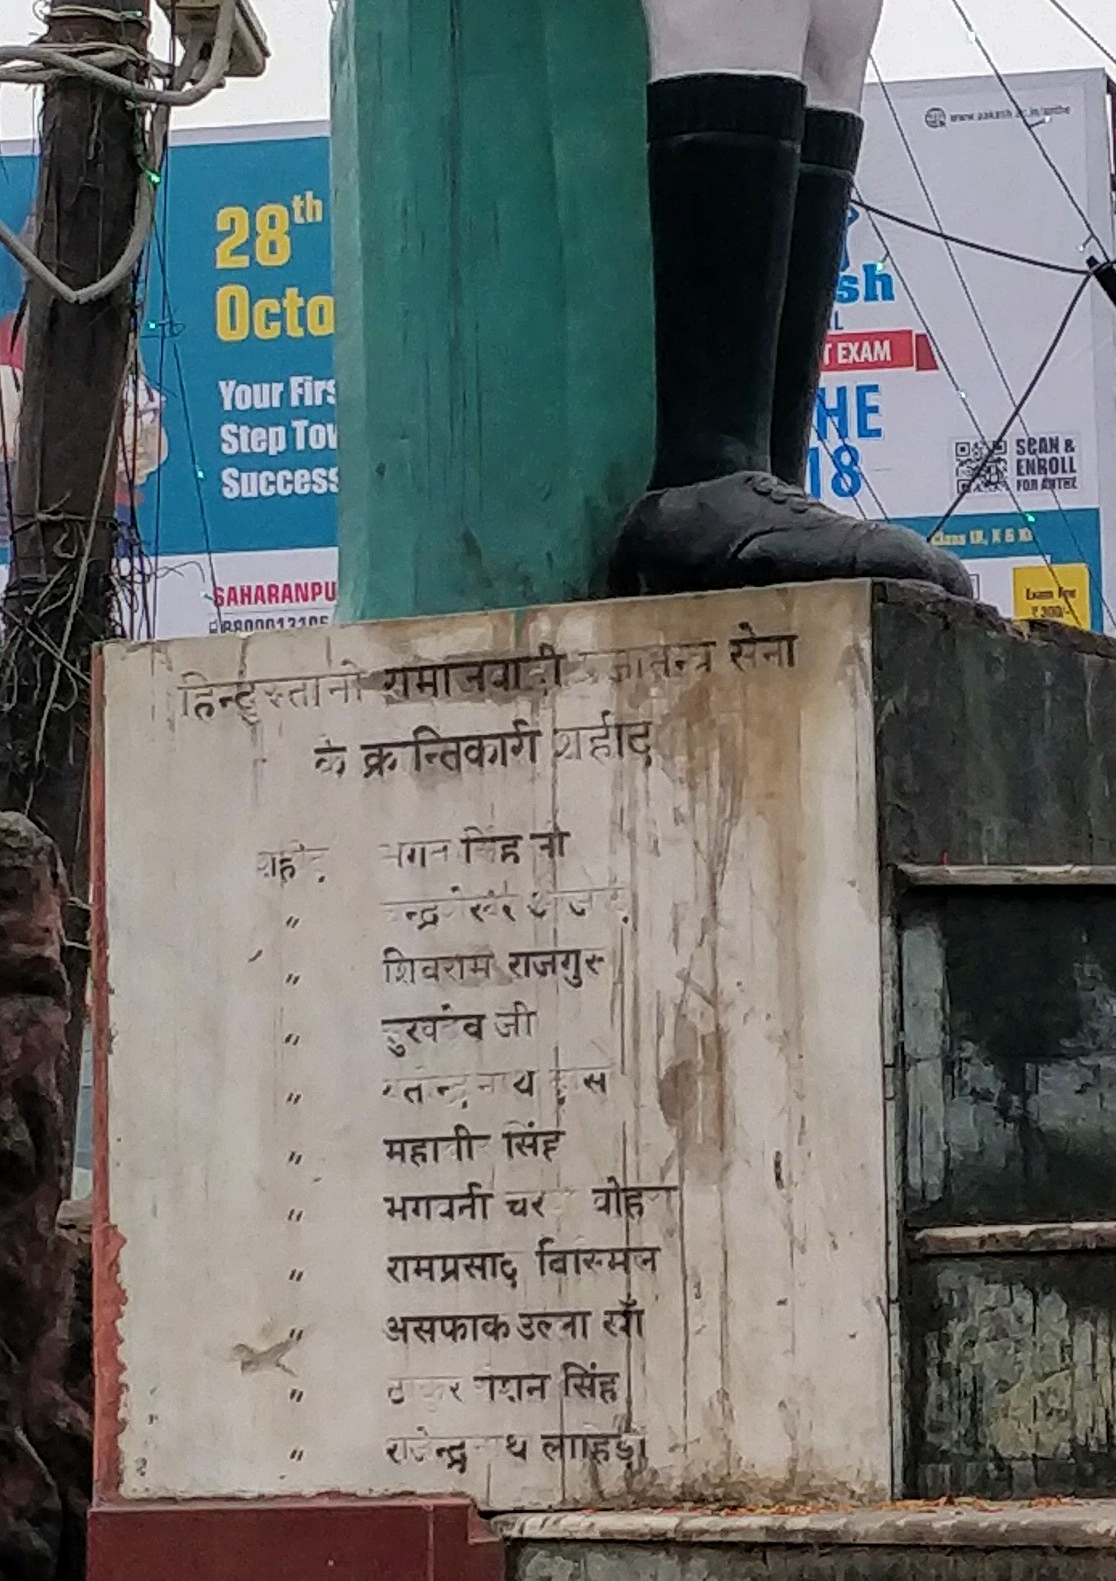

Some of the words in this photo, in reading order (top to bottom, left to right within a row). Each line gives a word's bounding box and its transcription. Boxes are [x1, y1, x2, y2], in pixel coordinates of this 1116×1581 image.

[837, 339, 892, 365] EXAM
[218, 379, 284, 411] Your
[220, 421, 287, 456] Step
[1016, 436, 1060, 456] SCAN
[1064, 437, 1076, 453] &
[1016, 455, 1077, 476] ENROLL
[221, 465, 339, 500] Success
[1016, 478, 1038, 492] FOR
[214, 581, 338, 608] SAHARANPU
